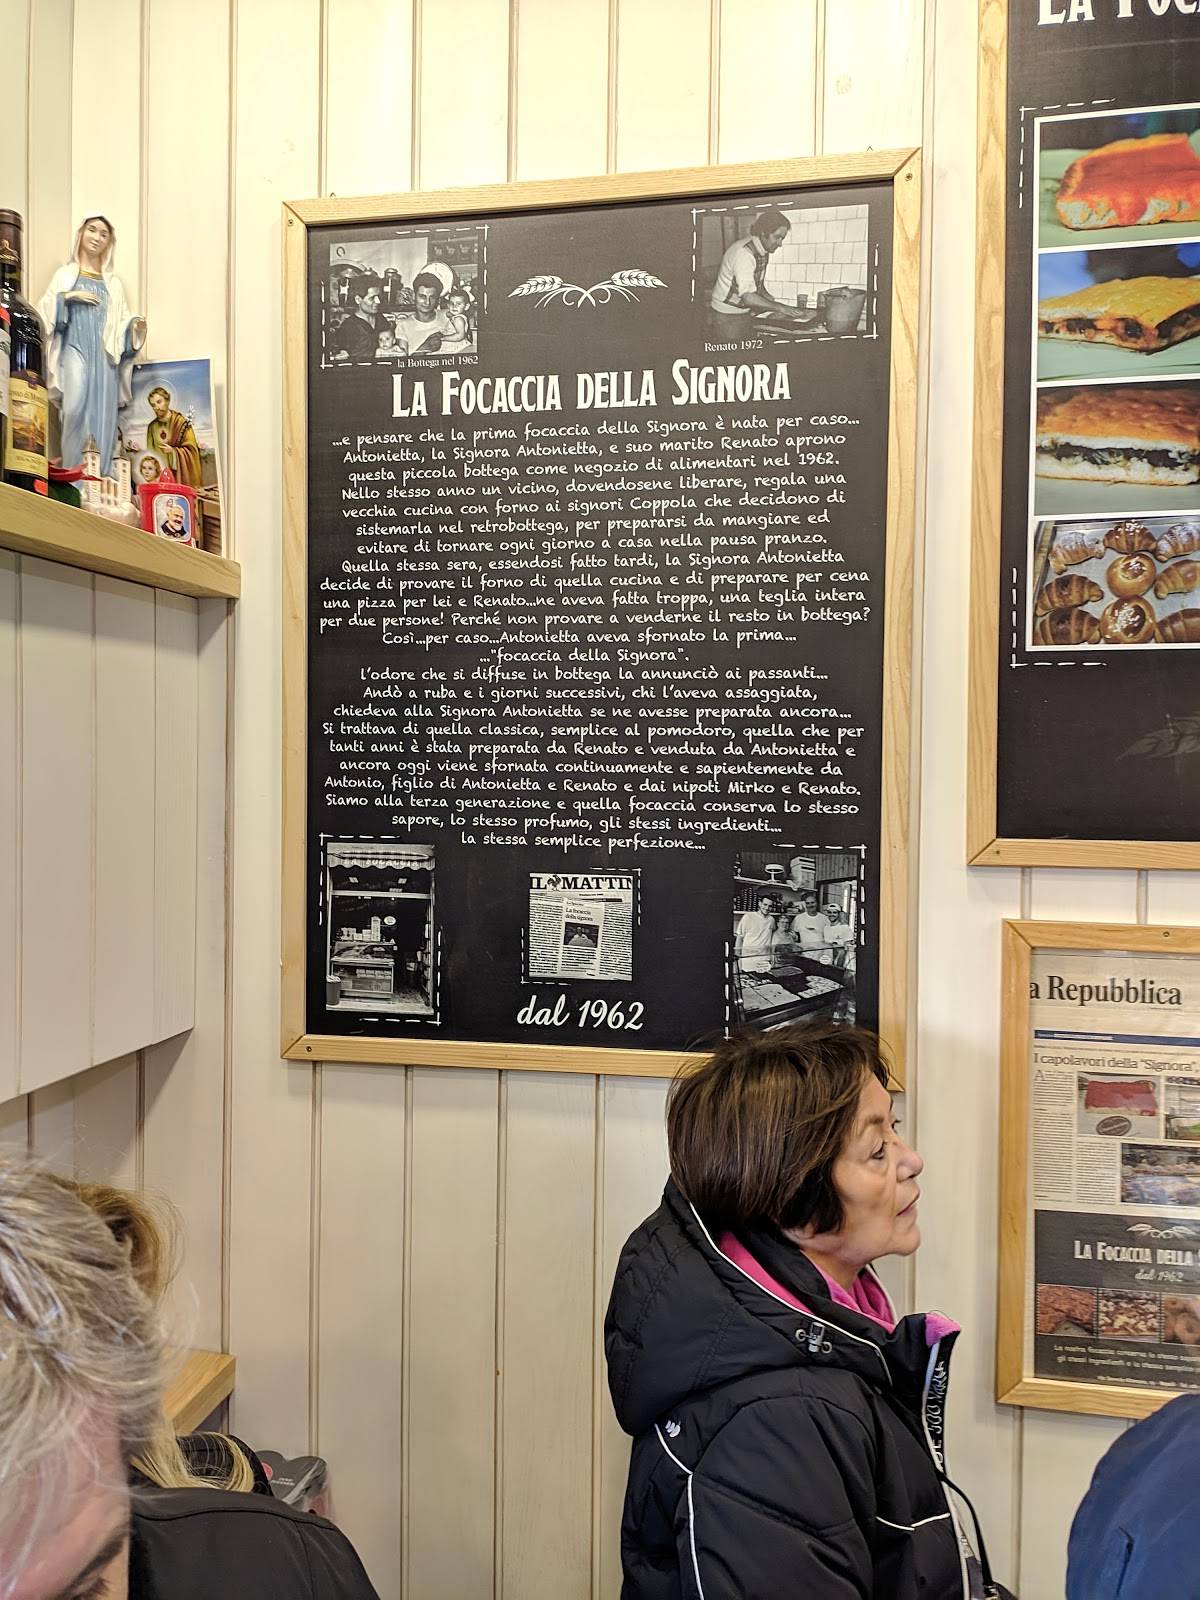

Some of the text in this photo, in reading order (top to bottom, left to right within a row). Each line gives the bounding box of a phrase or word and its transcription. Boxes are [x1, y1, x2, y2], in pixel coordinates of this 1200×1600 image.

[705, 339, 763, 352] Renato 1972
[397, 355, 479, 369] la Bottega nel 1962
[357, 433, 414, 453] pensare
[418, 428, 445, 442] che
[451, 427, 467, 441] la
[473, 427, 518, 448] prima
[523, 422, 591, 442] focaccia
[596, 419, 640, 435] della
[646, 420, 709, 438] Signora
[715, 414, 726, 430] è
[731, 414, 769, 429] nata
[776, 416, 803, 436] per
[343, 433, 847, 464] Antonietta, la Signora Antonietta, e suo marito Renato aprono
[341, 471, 847, 500] Nello stesso anno un vicino, dovendosene liberare, regala una
[356, 508, 831, 538] sistemarla nel retrobottega, per prepararsi da mangiare ed
[341, 548, 845, 574] Quella stessa sera, essendosi fatto tardi, la Signora Antonietta
[320, 605, 871, 635] per due persone! Perché non provare a venderne il resto in bottega?
[568, 647, 611, 662] della
[421, 667, 447, 681] che
[453, 668, 466, 681] si
[471, 664, 527, 684] diffuse
[532, 668, 549, 680] in
[555, 665, 612, 685] bottega
[618, 666, 635, 680] la
[641, 664, 719, 680] annunciò
[725, 667, 742, 680] ai
[333, 702, 398, 717] chiedeva
[403, 704, 434, 717] alla
[439, 704, 497, 722] Signora
[502, 703, 583, 718] Antonietta
[590, 707, 606, 718] se
[612, 707, 633, 718] ne
[638, 707, 689, 718] avesse
[695, 703, 773, 726] preparata
[329, 738, 856, 761] tanti anni è stata preparata da Renato e venduta da Antonietta e
[324, 773, 861, 801] Antonio, figlio di Antonietta e Renato e dai nipoti Mirko e Renato.
[391, 815, 444, 832] sapore,
[450, 813, 466, 826] lo
[472, 813, 518, 827] stesso
[524, 812, 593, 835] profumo,
[599, 815, 622, 834] gli
[628, 815, 672, 830] stessi
[461, 831, 477, 845] la
[483, 831, 528, 846] stessa
[534, 833, 602, 854] semplice
[530, 876, 547, 890] IL
[1046, 975, 1182, 1006] Repubblica
[517, 994, 644, 1030] dal 1962
[1040, 1054, 1106, 1067] capolavori
[1107, 1057, 1138, 1069] della
